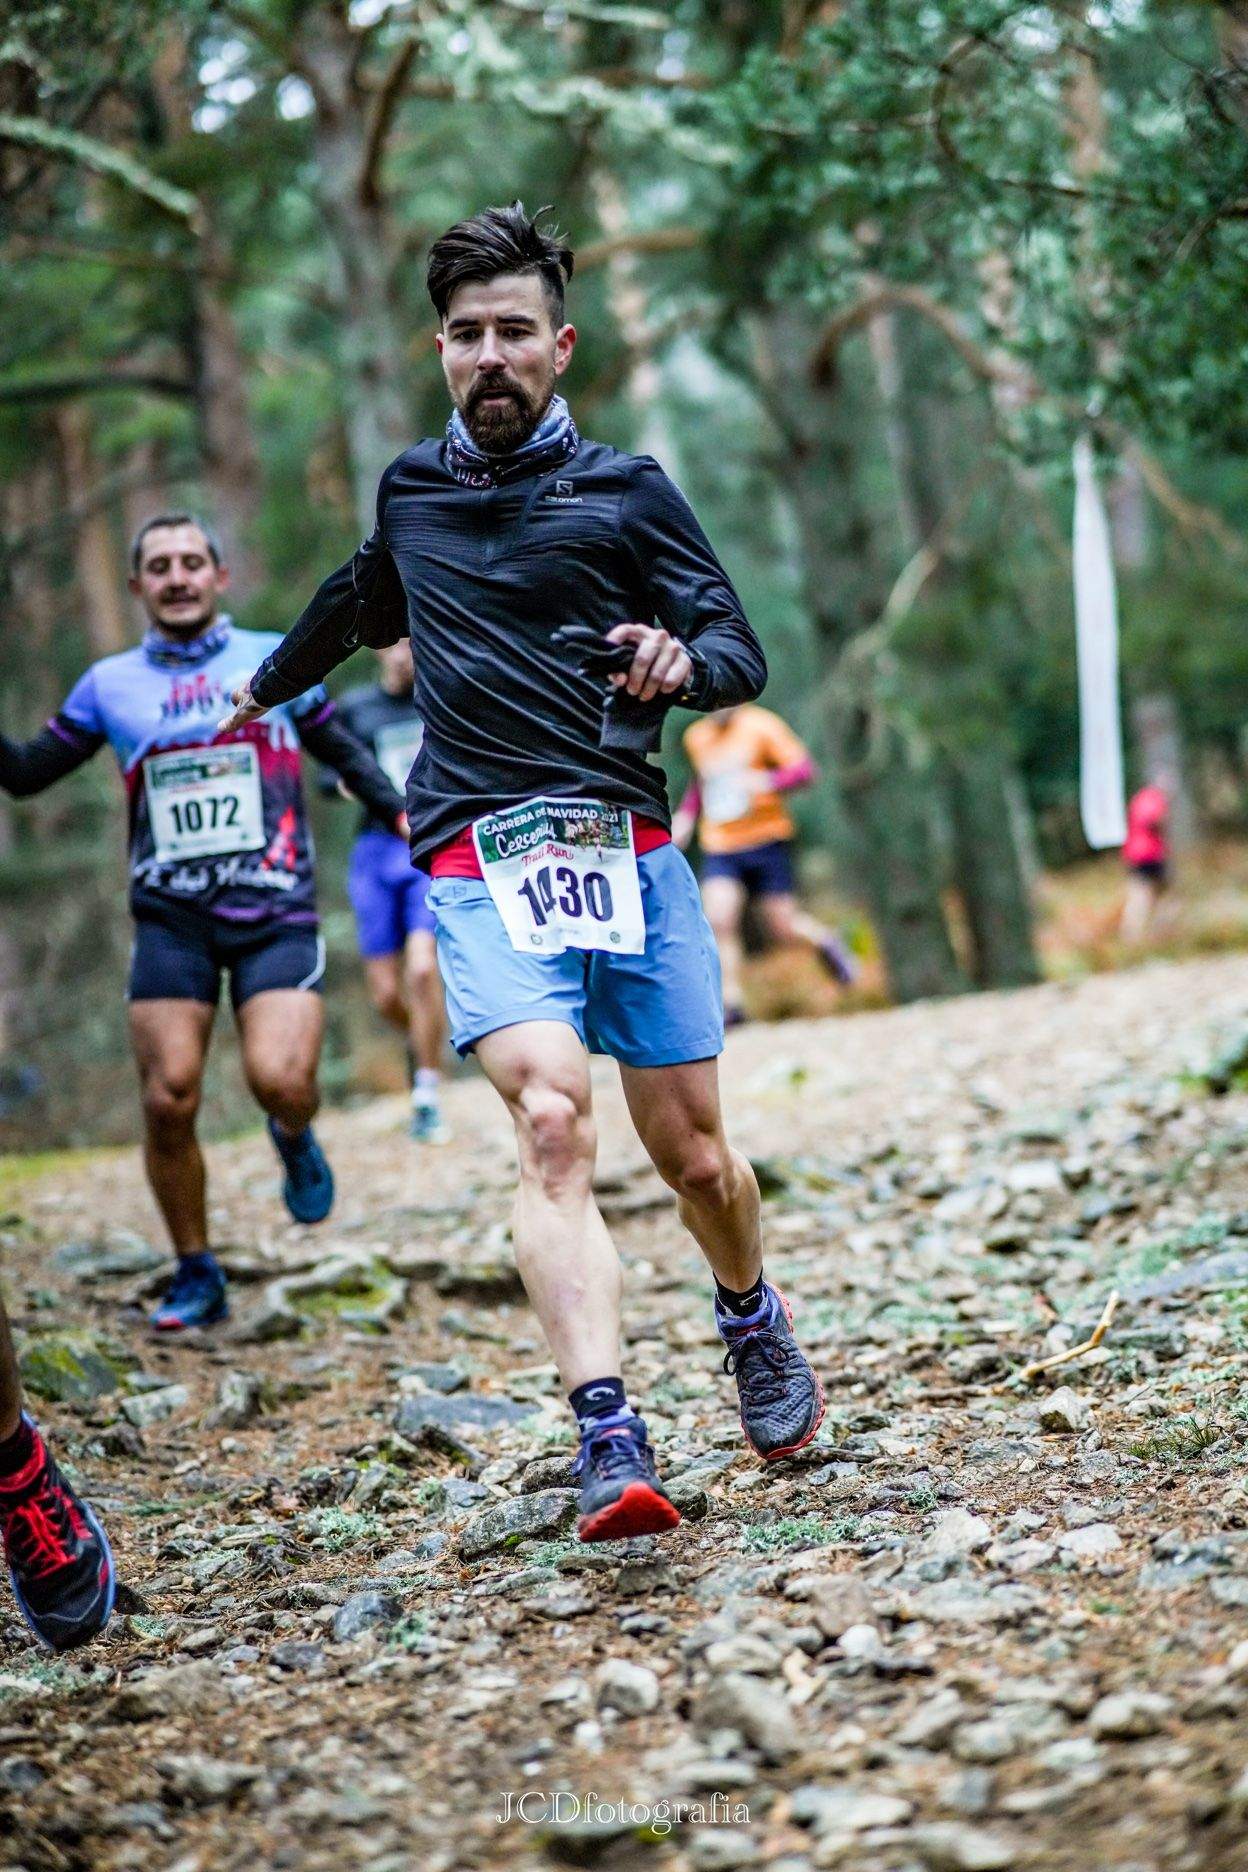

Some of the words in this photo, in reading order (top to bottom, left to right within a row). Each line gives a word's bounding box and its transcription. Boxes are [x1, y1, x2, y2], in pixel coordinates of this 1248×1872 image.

[170, 796, 240, 834] 1072
[483, 811, 535, 836] CARRERA
[535, 806, 547, 819] DE
[547, 807, 598, 820] NAVIDAD
[518, 866, 613, 926] 1430
